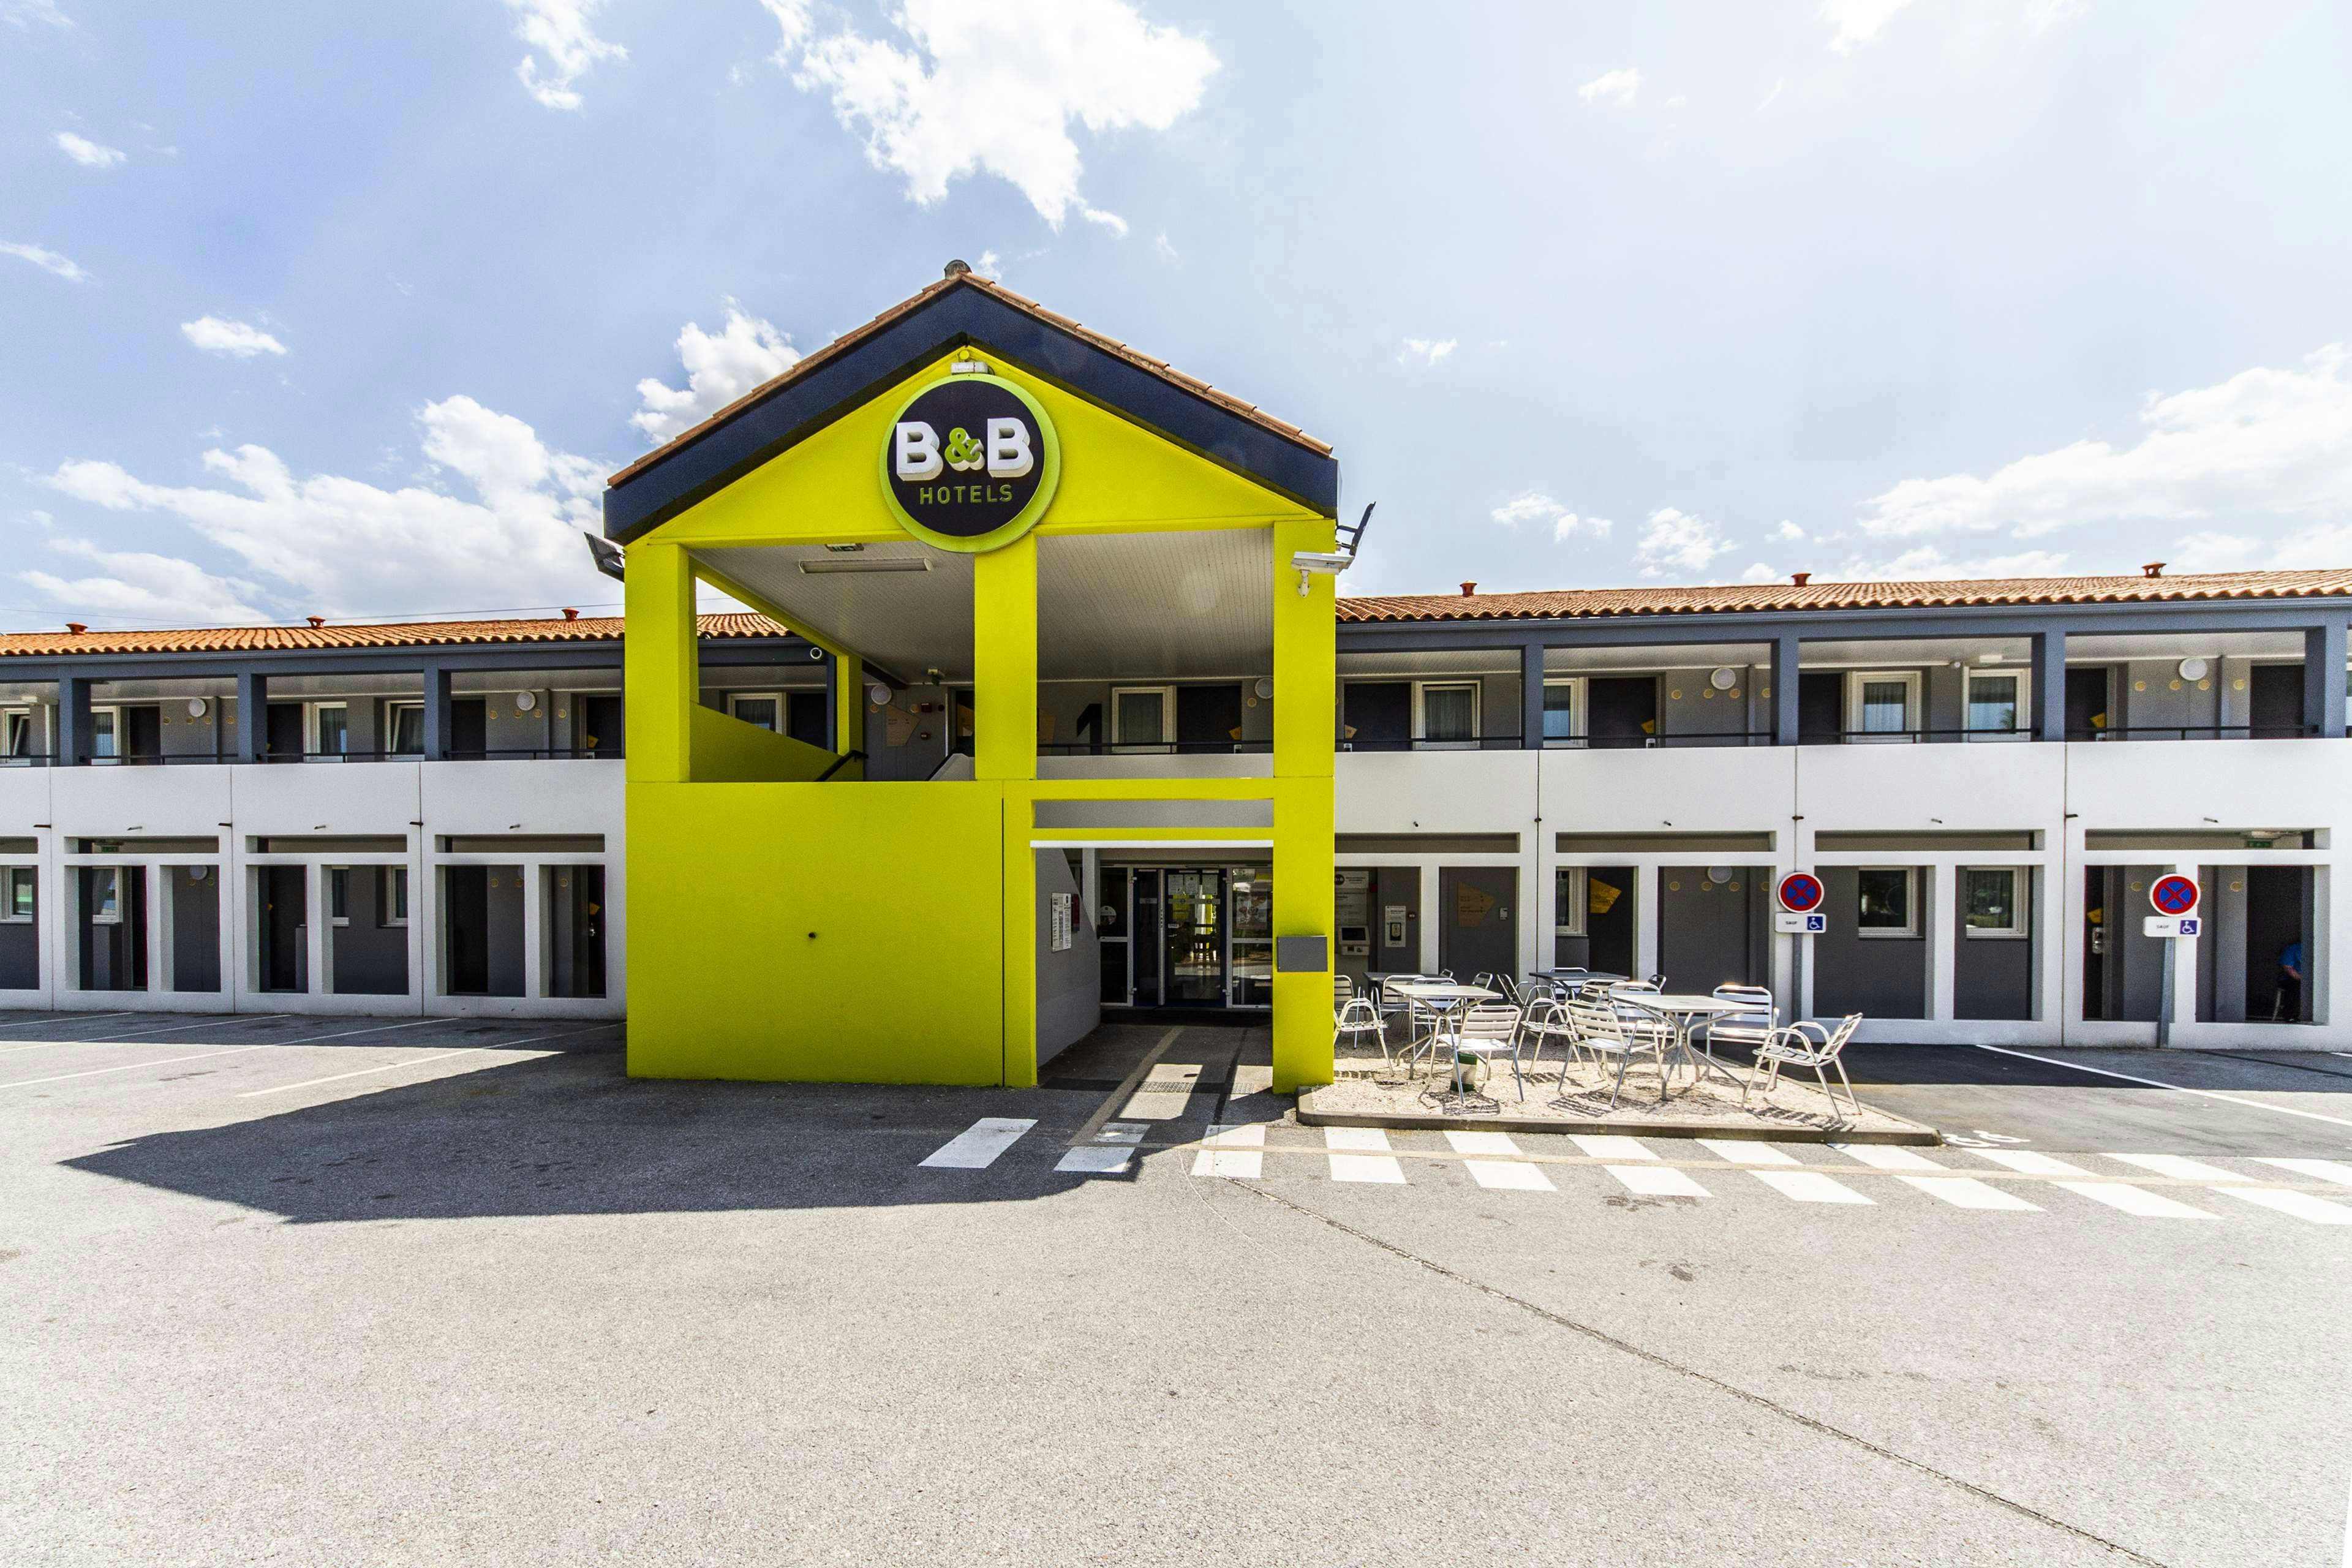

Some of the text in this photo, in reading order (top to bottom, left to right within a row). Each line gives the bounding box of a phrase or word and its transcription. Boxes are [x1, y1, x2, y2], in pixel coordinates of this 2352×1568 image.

[896, 417, 1033, 481] B&B
[920, 484, 1012, 505] HOTELS
[1076, 703, 1102, 755] 1
